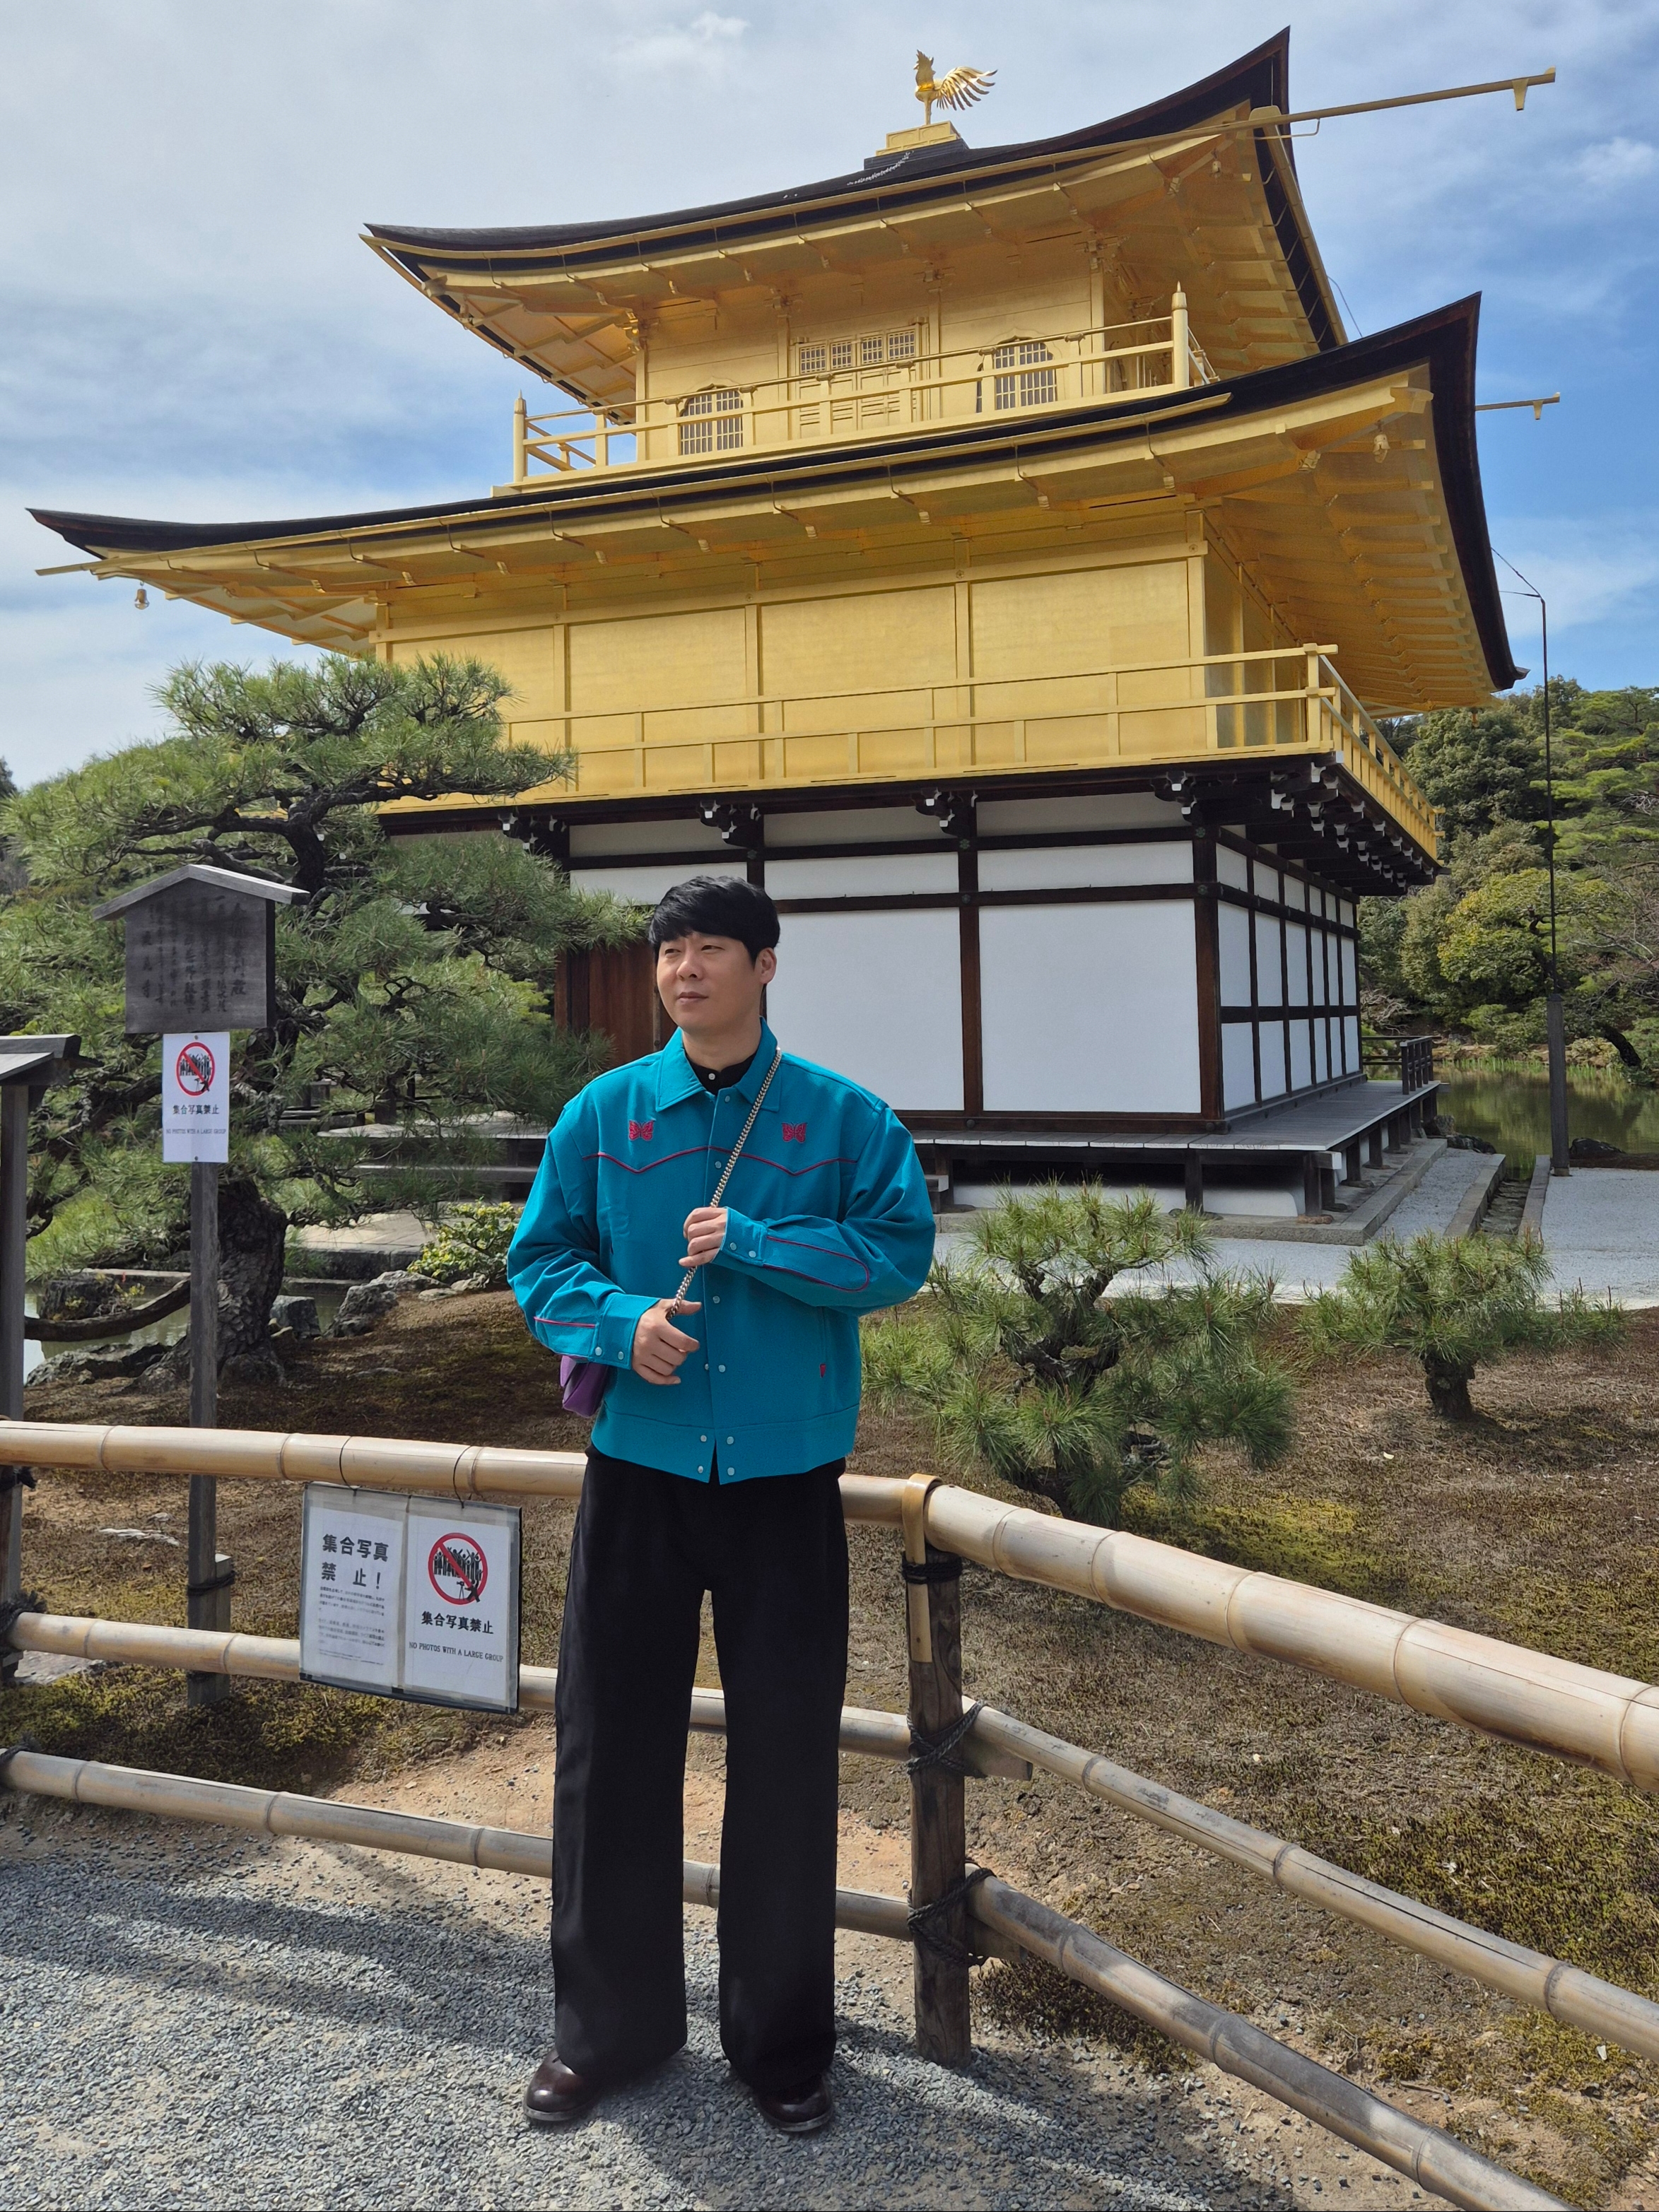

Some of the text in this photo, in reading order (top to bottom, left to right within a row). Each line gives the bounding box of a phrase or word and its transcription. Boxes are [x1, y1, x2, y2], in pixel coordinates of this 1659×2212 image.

[172, 1104, 220, 1114] 集合写真禁止
[322, 1534, 389, 1562] 集合写真
[421, 1611, 494, 1635] 集合写真禁止
[418, 1642, 440, 1652] PHOTOS
[442, 1646, 456, 1655] WITH
[464, 1649, 483, 1659] LARGE
[484, 1652, 504, 1662] GROUP
